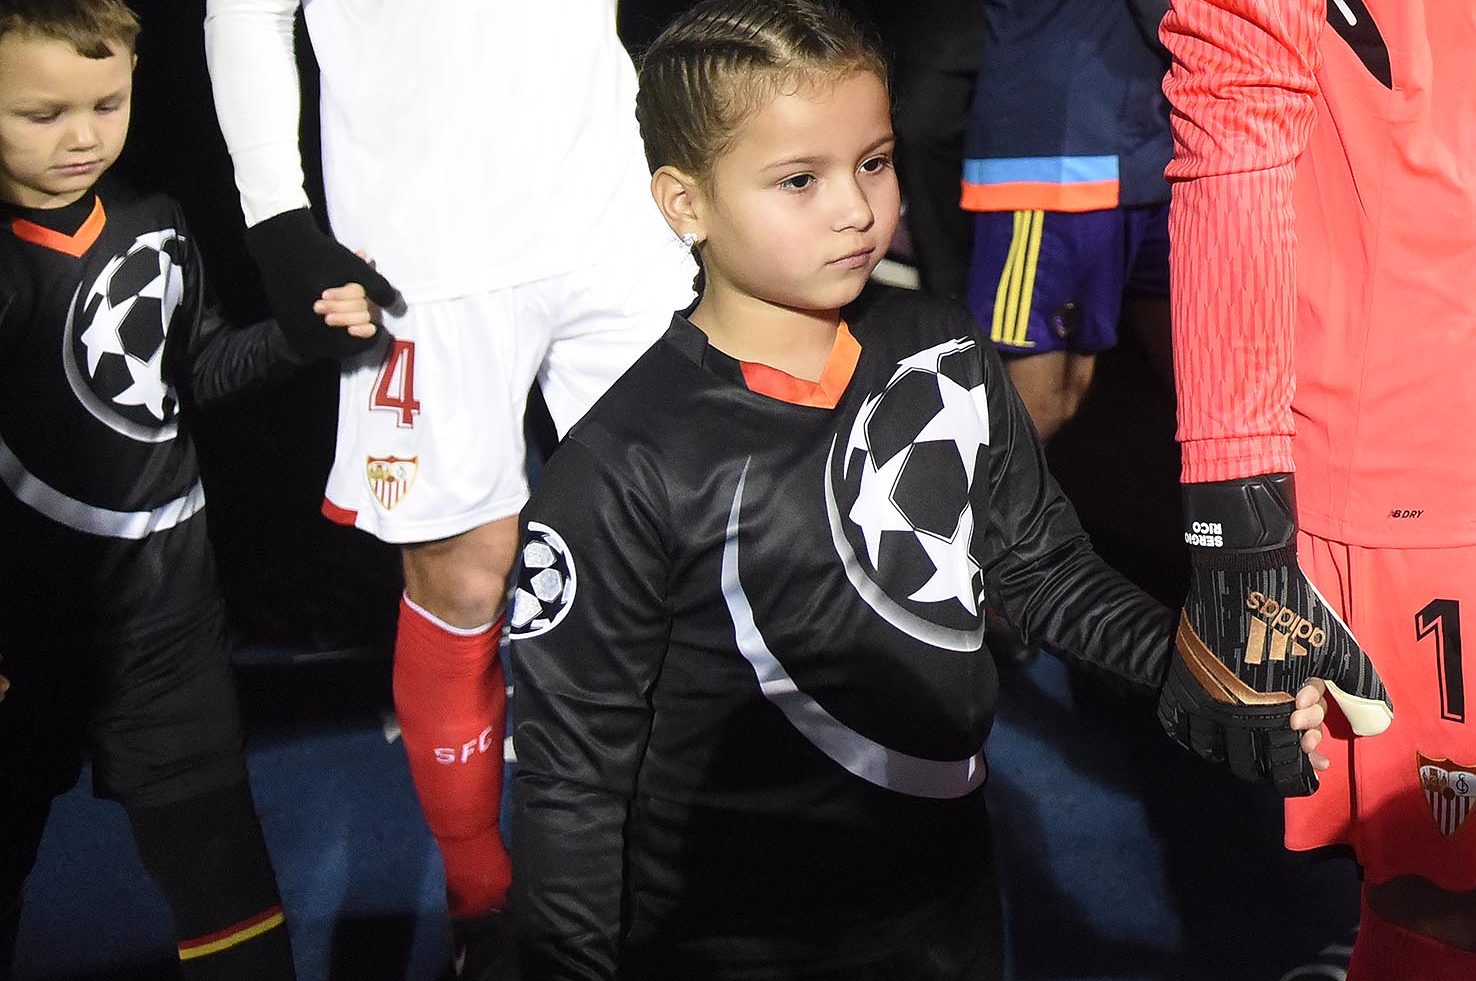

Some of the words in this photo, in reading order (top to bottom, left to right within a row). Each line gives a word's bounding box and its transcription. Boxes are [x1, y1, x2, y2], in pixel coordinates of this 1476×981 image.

[369, 339, 420, 429] 4
[1192, 521, 1222, 535] RICO
[1401, 509, 1425, 518] DRY
[1184, 532, 1224, 548] SERGIO
[1246, 590, 1327, 649] adidas
[1414, 598, 1466, 725] 1
[432, 725, 495, 766] SFC
